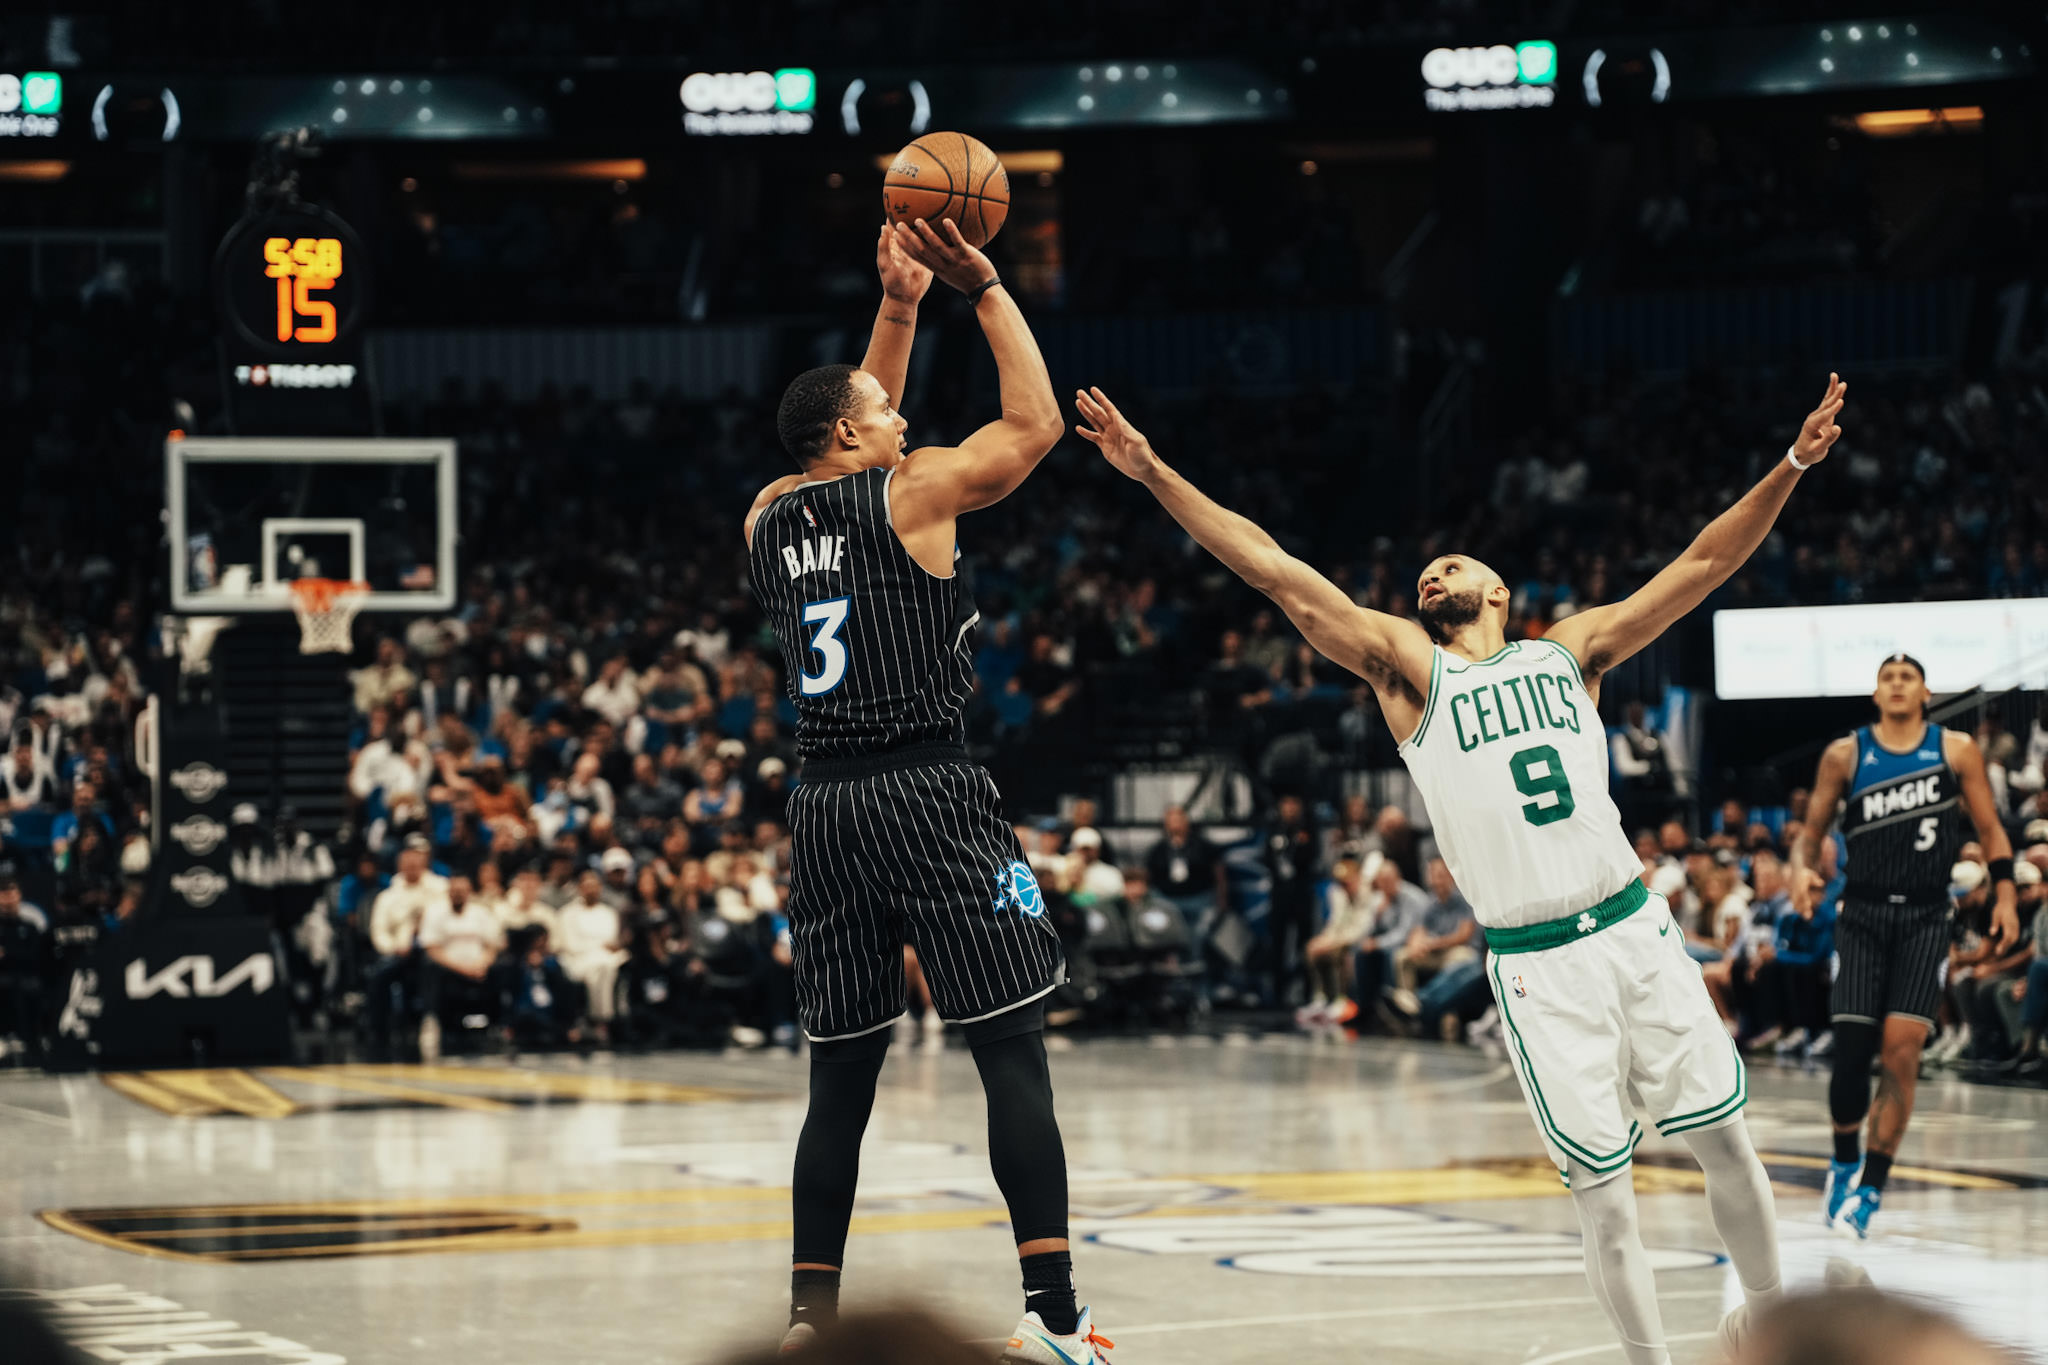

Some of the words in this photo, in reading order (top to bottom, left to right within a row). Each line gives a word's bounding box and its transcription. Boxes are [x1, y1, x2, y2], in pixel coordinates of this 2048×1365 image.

[277, 276, 337, 343] 15
[782, 535, 846, 580] BANE
[801, 595, 851, 697] 3
[1450, 673, 1581, 753] CELTICS
[1509, 744, 1576, 826] 9
[1862, 774, 1941, 821] MAGIC
[1914, 817, 1939, 852] 5
[125, 954, 274, 999] KIA
